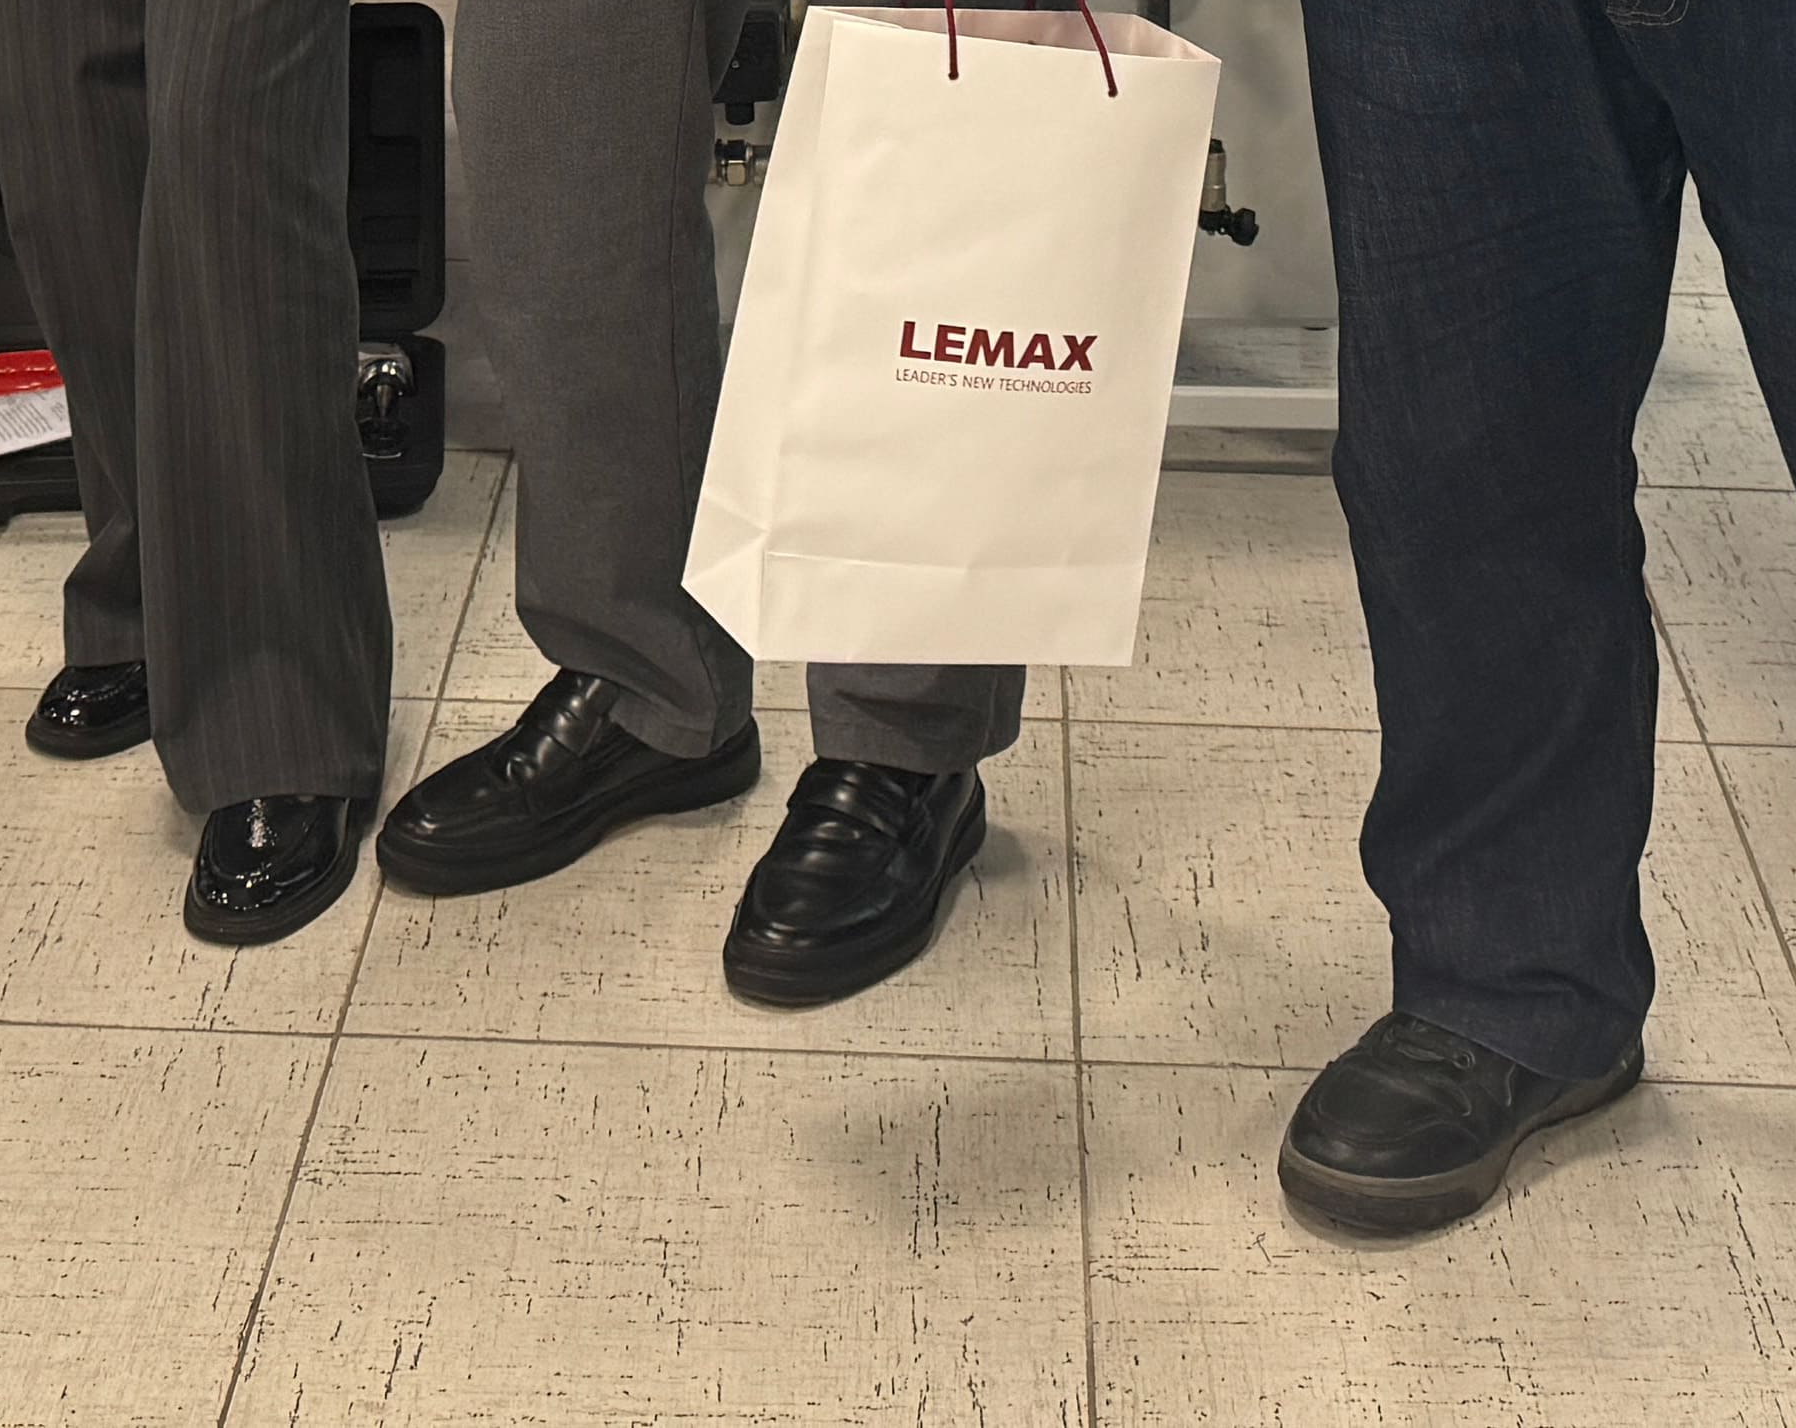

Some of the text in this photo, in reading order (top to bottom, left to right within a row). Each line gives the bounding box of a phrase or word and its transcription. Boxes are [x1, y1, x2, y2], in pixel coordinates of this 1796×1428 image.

[899, 320, 1098, 372] LEMAX
[962, 375, 995, 390] NEW
[999, 377, 1093, 394] TECHNOLOGIES
